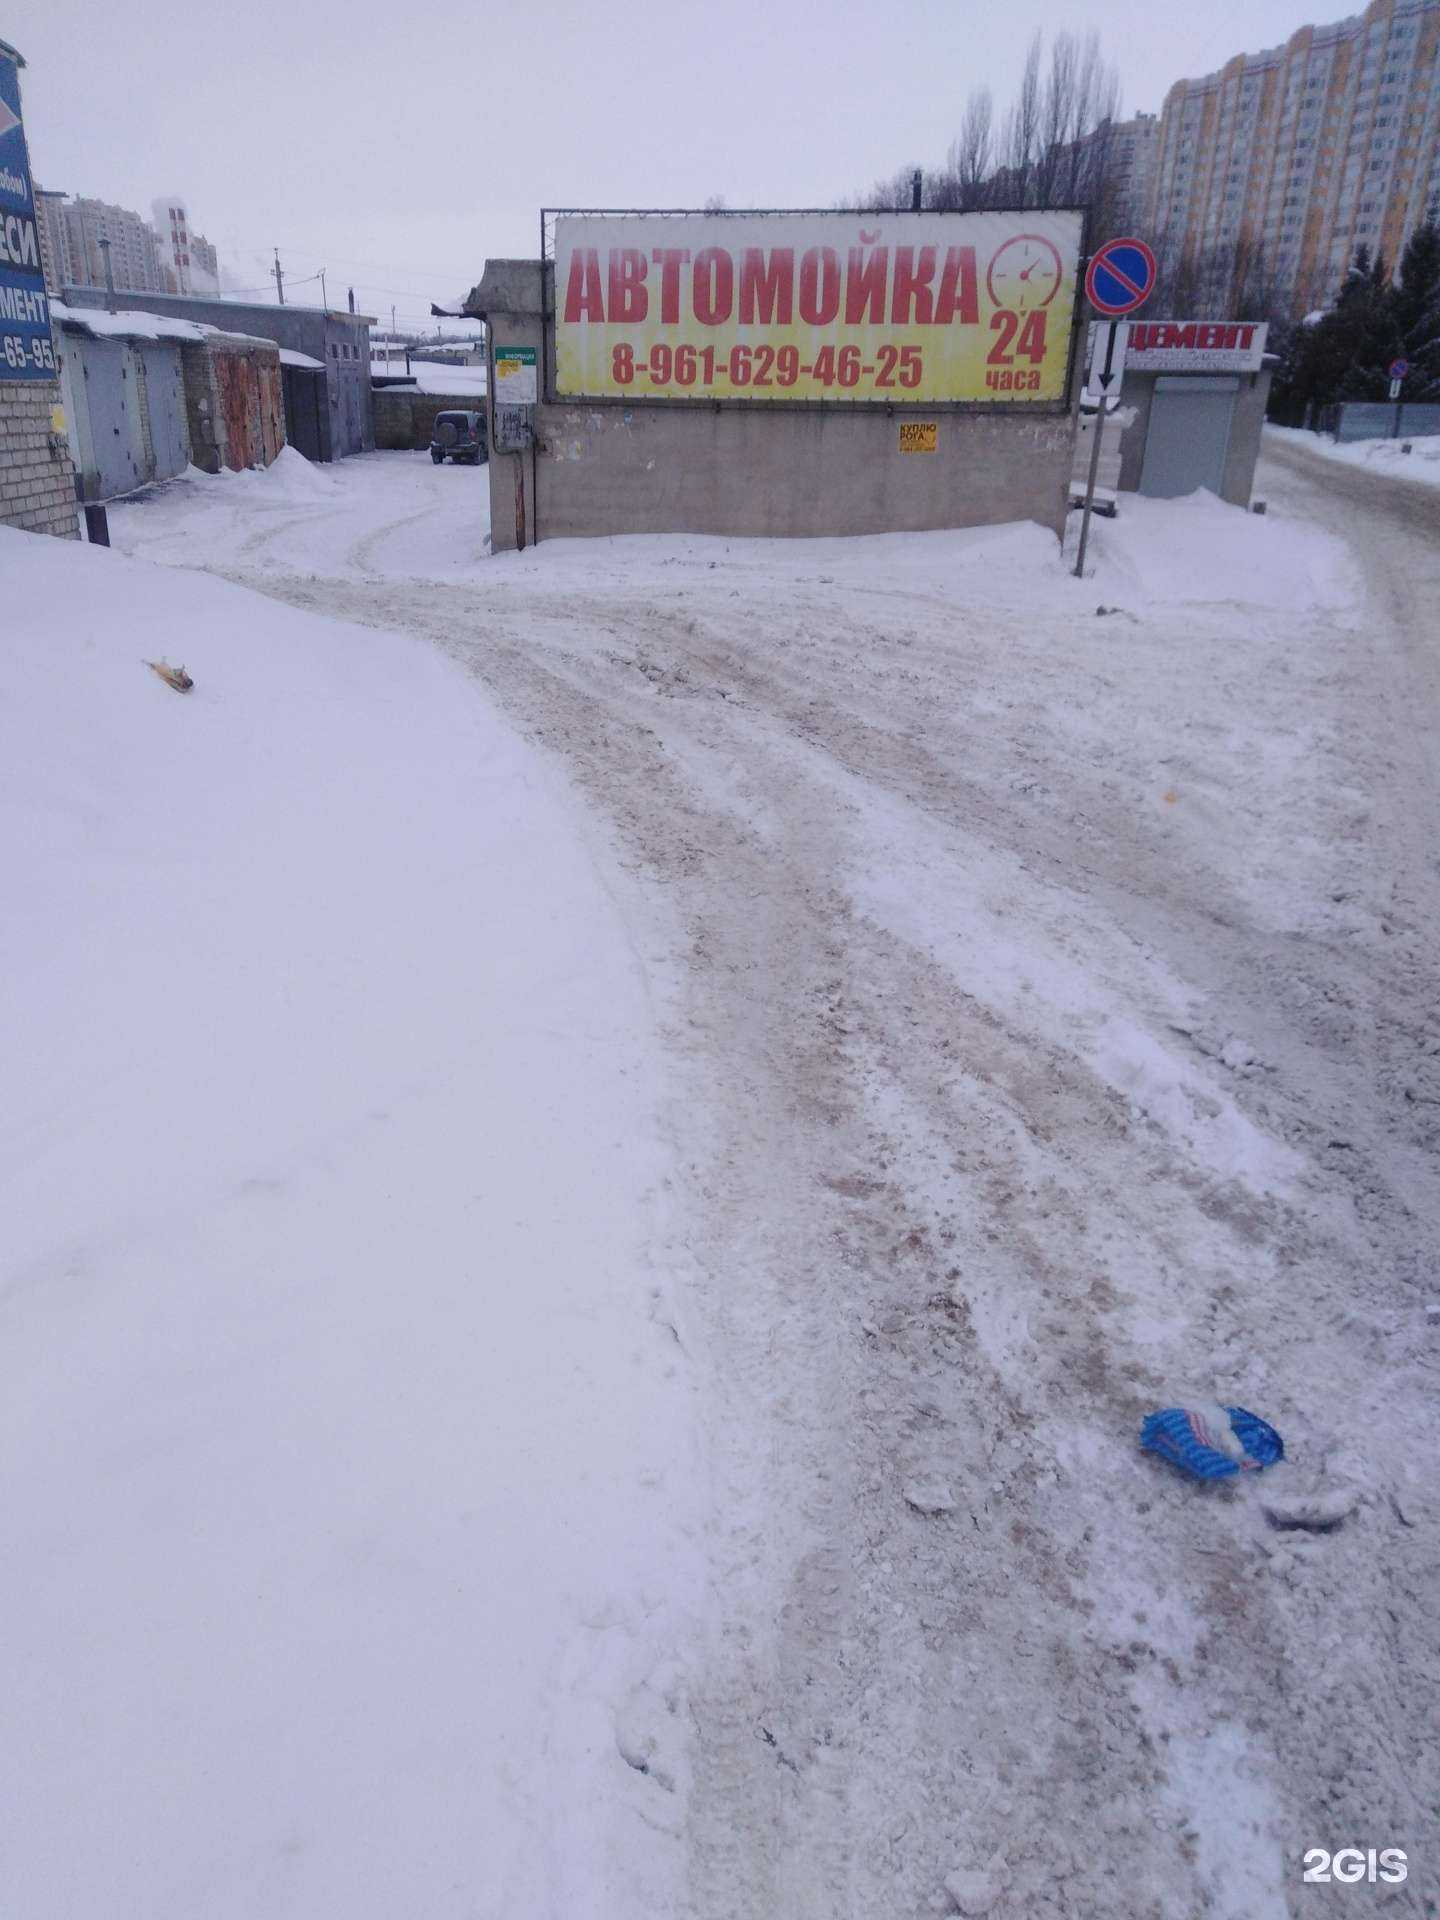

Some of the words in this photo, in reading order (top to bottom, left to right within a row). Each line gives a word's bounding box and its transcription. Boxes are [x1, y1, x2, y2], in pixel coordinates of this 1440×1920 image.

[564, 229, 979, 325] АВТОМОЙКА
[987, 309, 1048, 365] 24
[1127, 323, 1258, 351] ЦЕМЕНТ
[612, 342, 923, 388] 8-961-629-46-25
[986, 369, 1041, 390] часа
